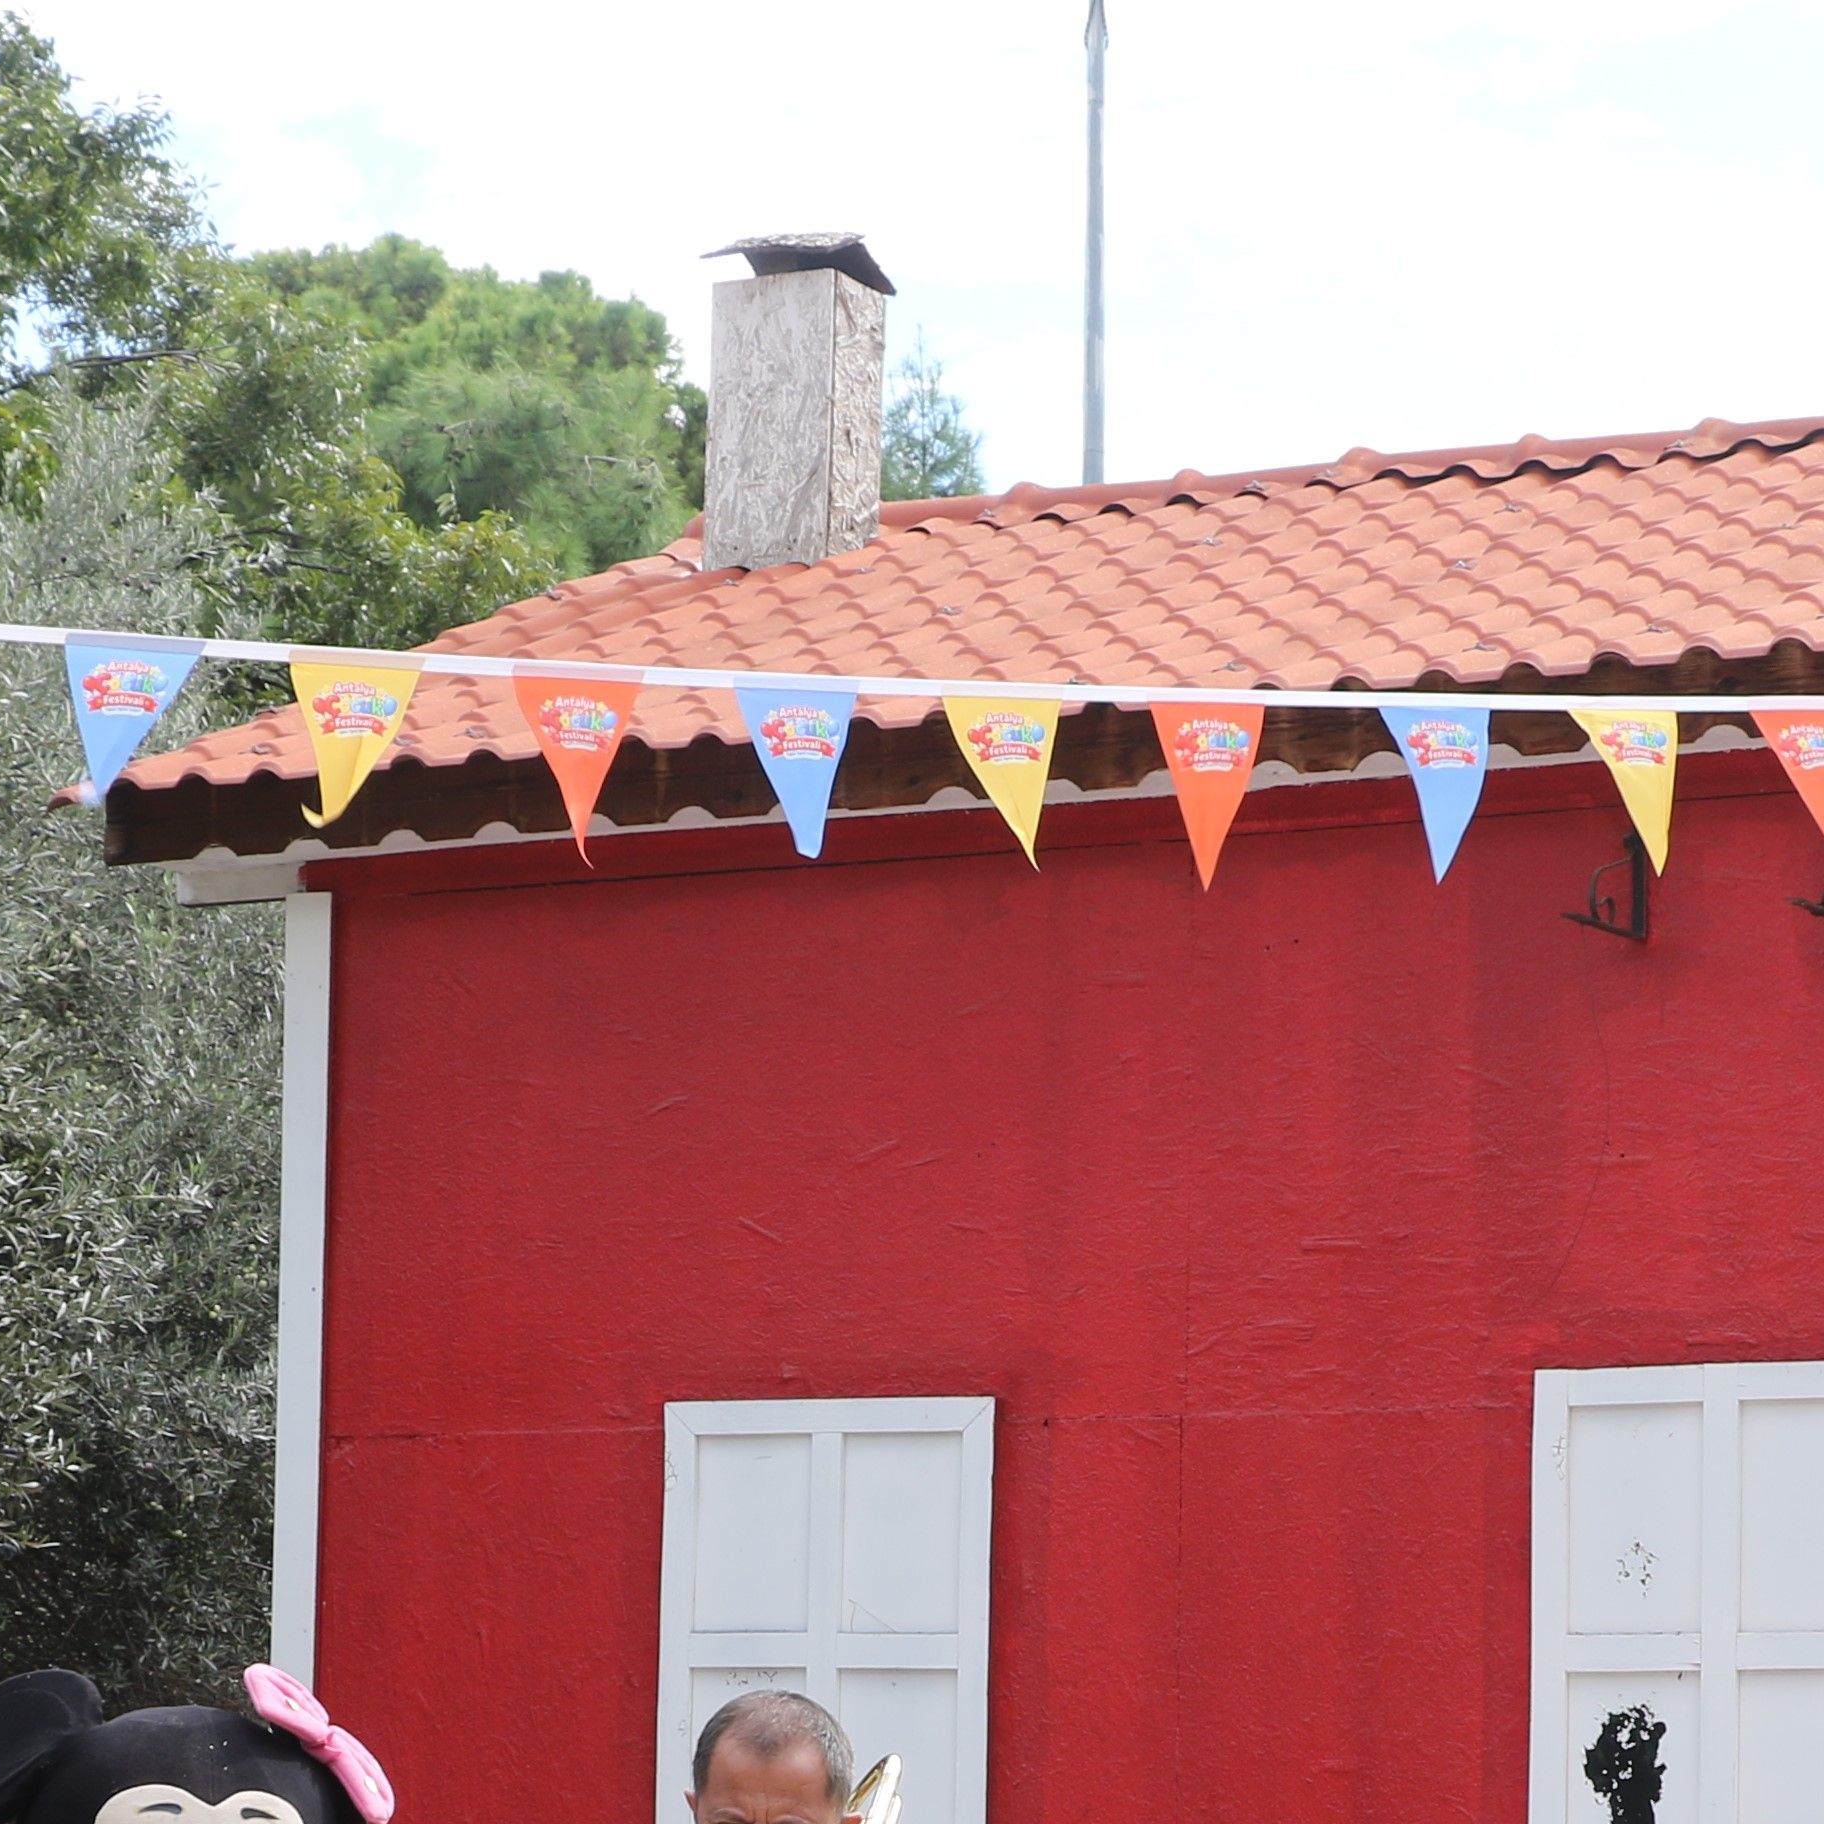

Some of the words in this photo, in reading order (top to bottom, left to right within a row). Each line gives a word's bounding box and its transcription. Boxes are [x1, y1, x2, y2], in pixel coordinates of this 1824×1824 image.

[107, 661, 149, 675] Antalya
[334, 682, 376, 696] Antalya
[102, 694, 144, 706] Festivali
[555, 696, 595, 710] Antalya
[779, 707, 818, 720] Antalya
[986, 713, 1024, 726] Antalya
[334, 717, 375, 730] Festivali
[1192, 719, 1228, 732] Antalya
[559, 730, 595, 742] Festivali
[782, 740, 821, 752] Festivali
[988, 747, 1028, 758] Festivali
[1193, 750, 1232, 763] Festivali
